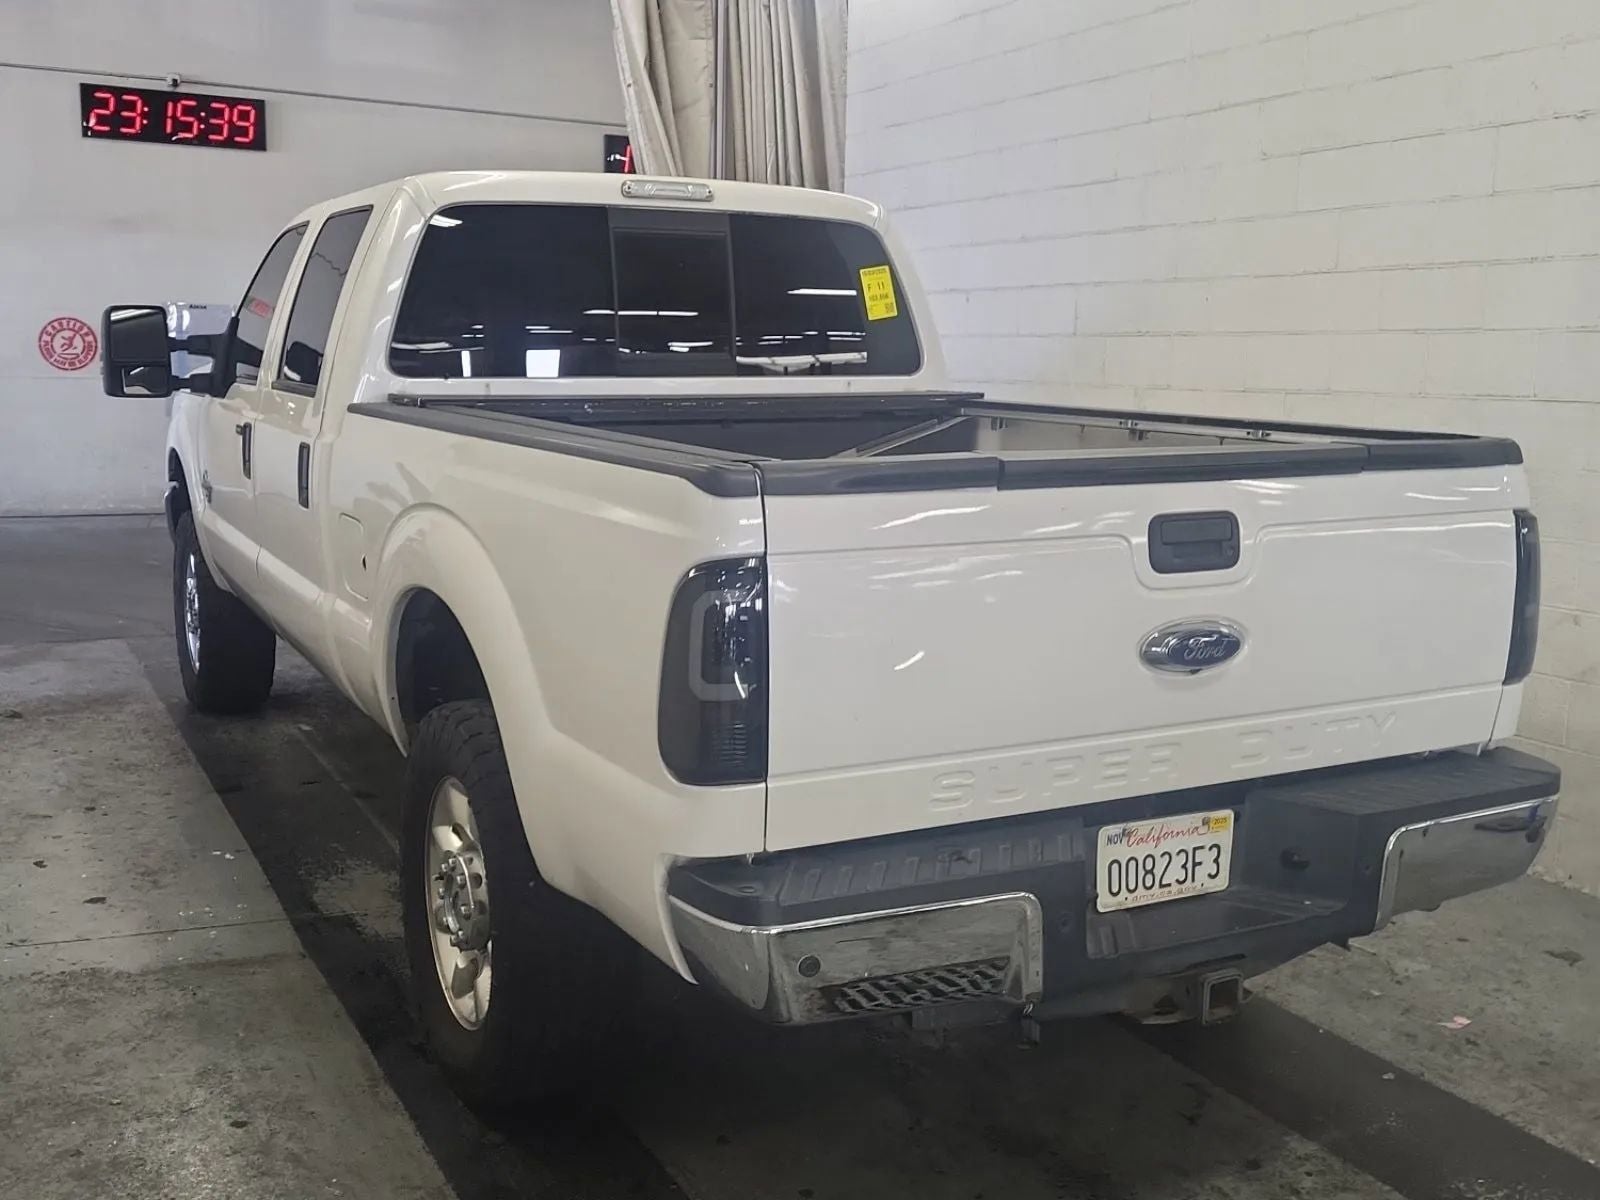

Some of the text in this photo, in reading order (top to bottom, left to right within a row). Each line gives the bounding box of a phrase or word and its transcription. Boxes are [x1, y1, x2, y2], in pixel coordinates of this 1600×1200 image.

[89, 90, 256, 143] 23:15:39
[1184, 635, 1227, 661] Ford
[930, 711, 1397, 813] SUPER DUTY
[1106, 823, 1202, 849] NOV California
[1107, 843, 1221, 897] 00823F3
